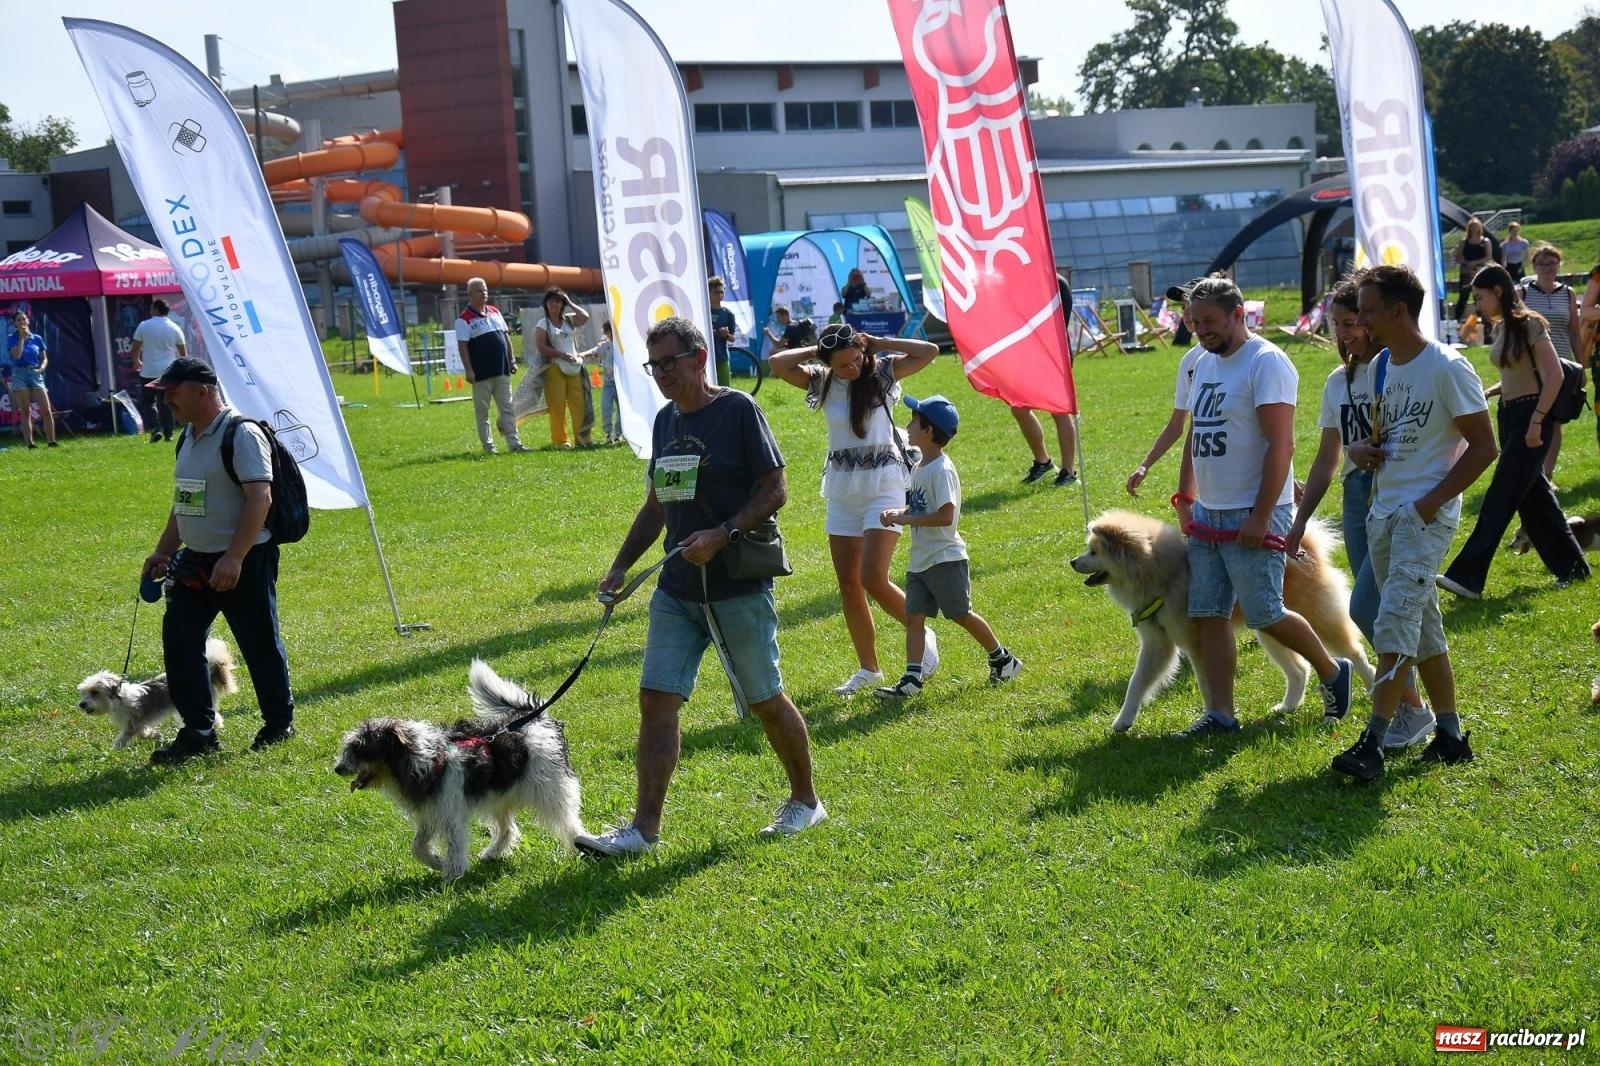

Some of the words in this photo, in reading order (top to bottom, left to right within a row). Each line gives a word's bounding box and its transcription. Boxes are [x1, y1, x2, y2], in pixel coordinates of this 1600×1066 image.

[0, 275, 64, 293] NATURAL
[114, 272, 142, 288] 75%
[1194, 382, 1227, 417] The
[664, 471, 681, 487] 24
[179, 491, 191, 503] 52
